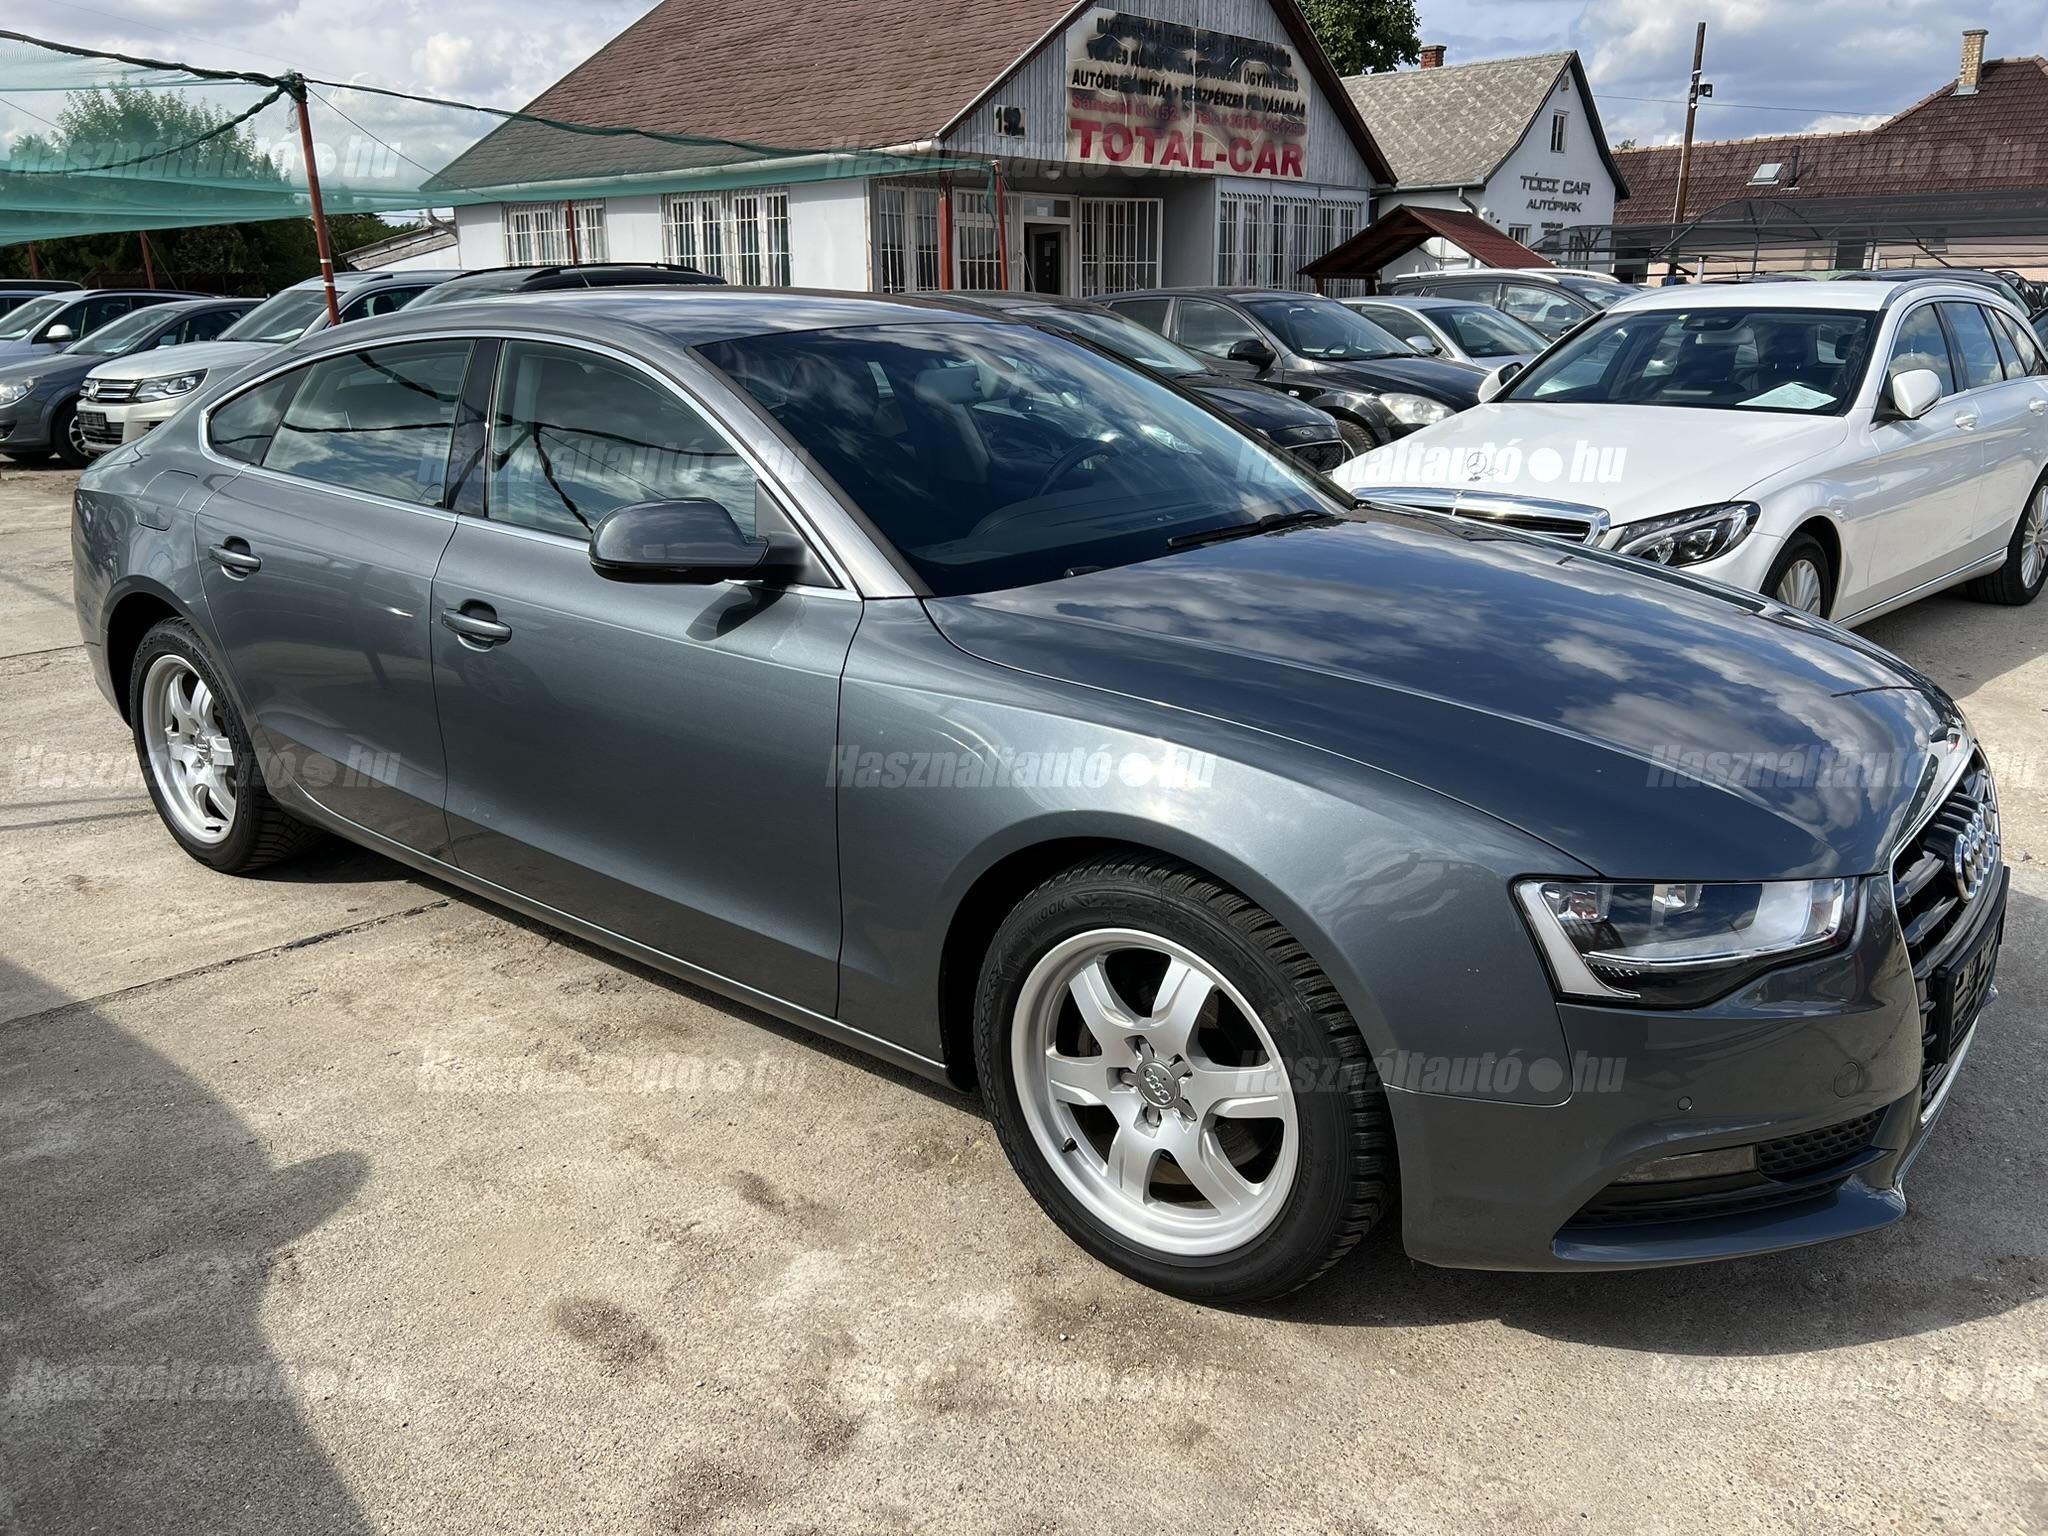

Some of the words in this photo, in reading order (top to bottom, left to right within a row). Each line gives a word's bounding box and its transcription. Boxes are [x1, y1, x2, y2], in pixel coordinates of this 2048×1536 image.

[1070, 119, 1303, 177] TOTAL-CAR
[1563, 180, 1591, 196] CAR
[1526, 197, 1582, 212] AUTÓPARK
